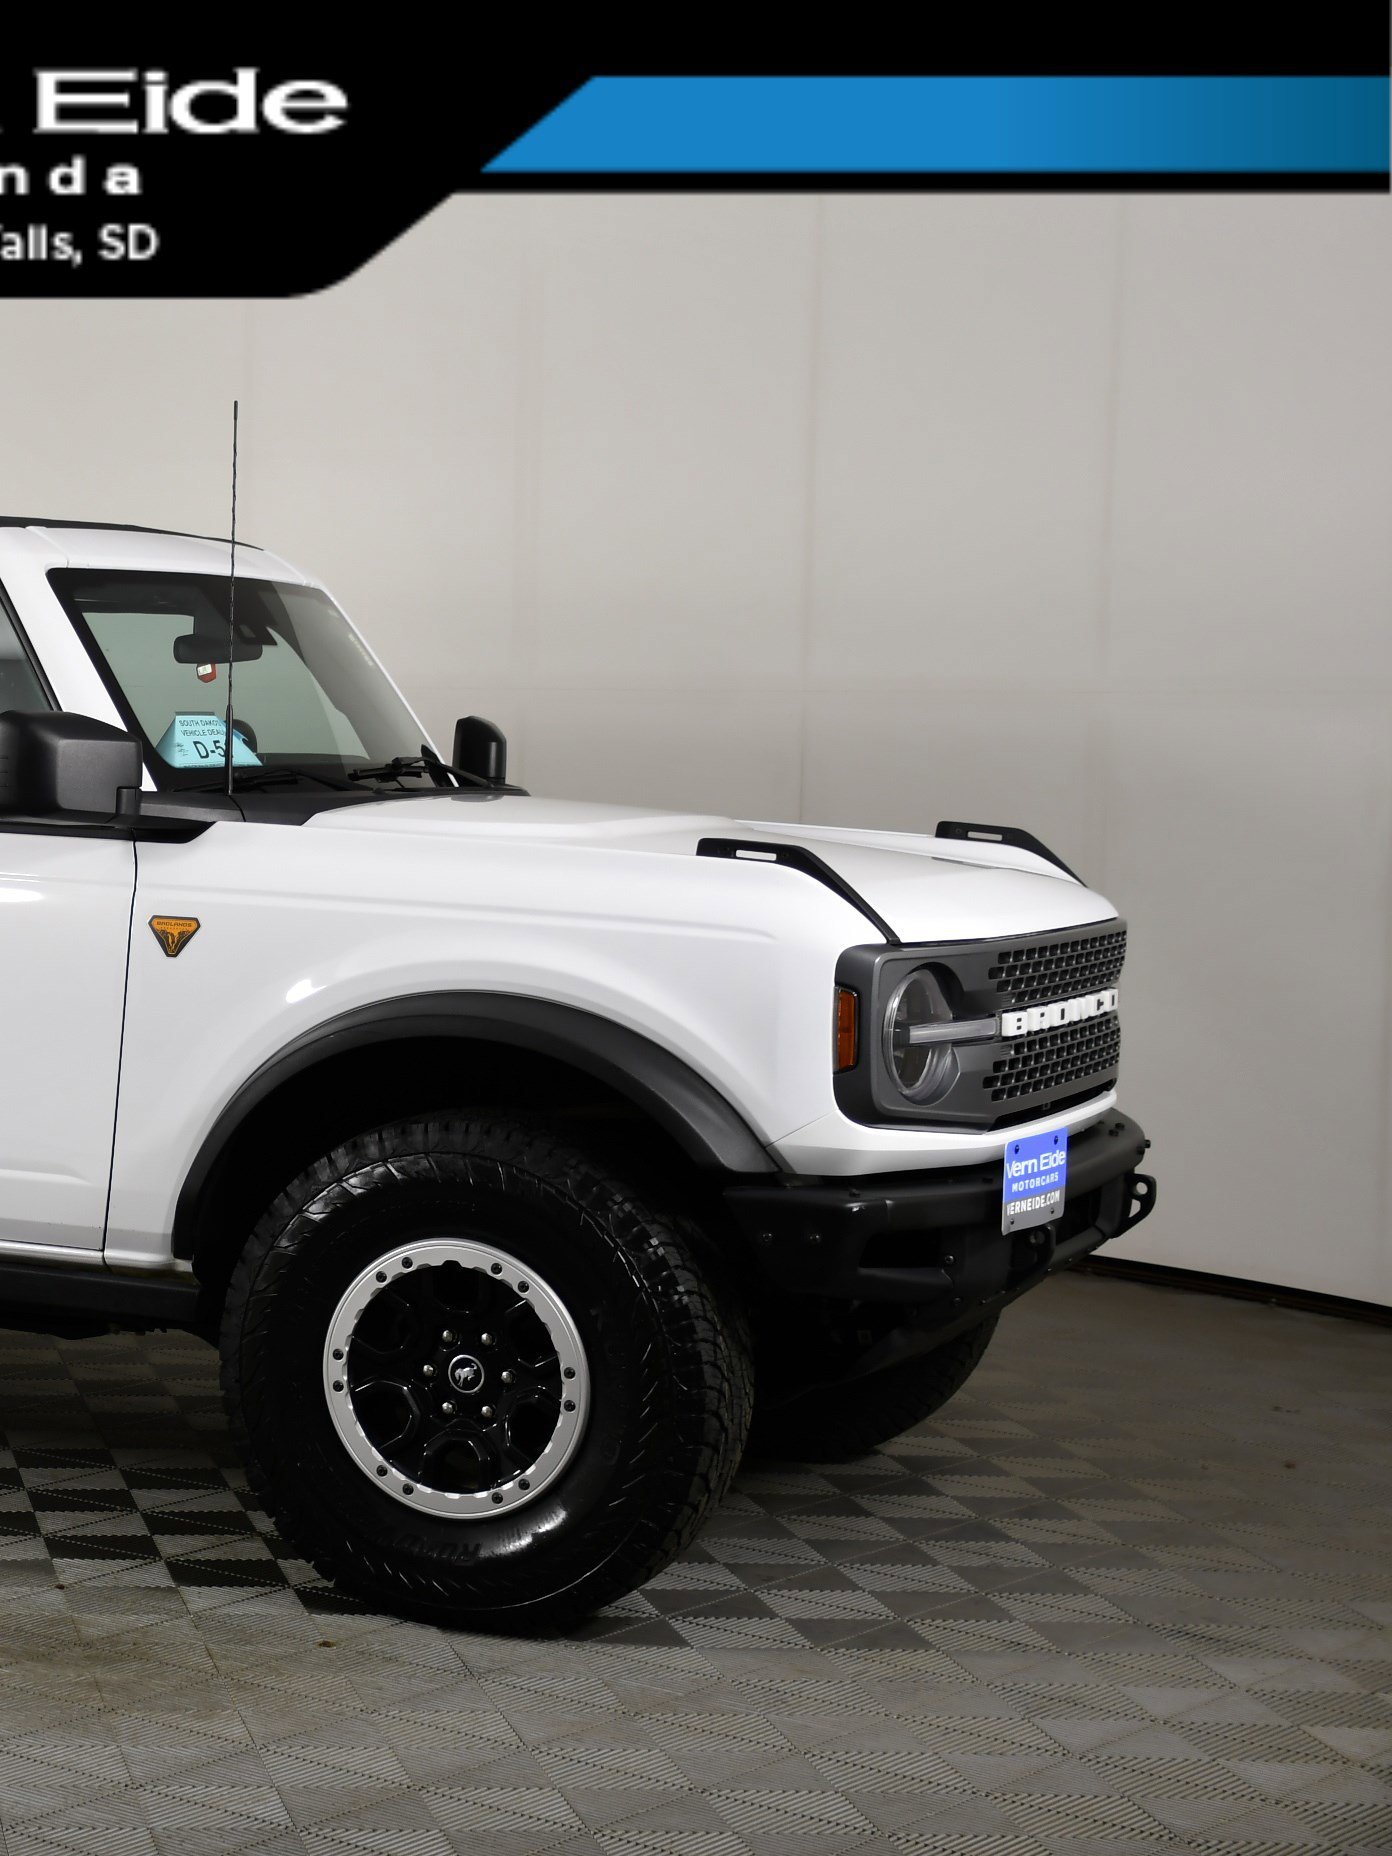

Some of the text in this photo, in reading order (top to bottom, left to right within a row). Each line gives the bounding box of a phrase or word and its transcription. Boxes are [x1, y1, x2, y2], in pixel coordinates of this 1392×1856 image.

[178, 719, 200, 727] SOUTH
[180, 729, 207, 737] VEHICLE
[1006, 1149, 1066, 1179] Vern Eide
[1011, 1171, 1059, 1193] MOTORCARS
